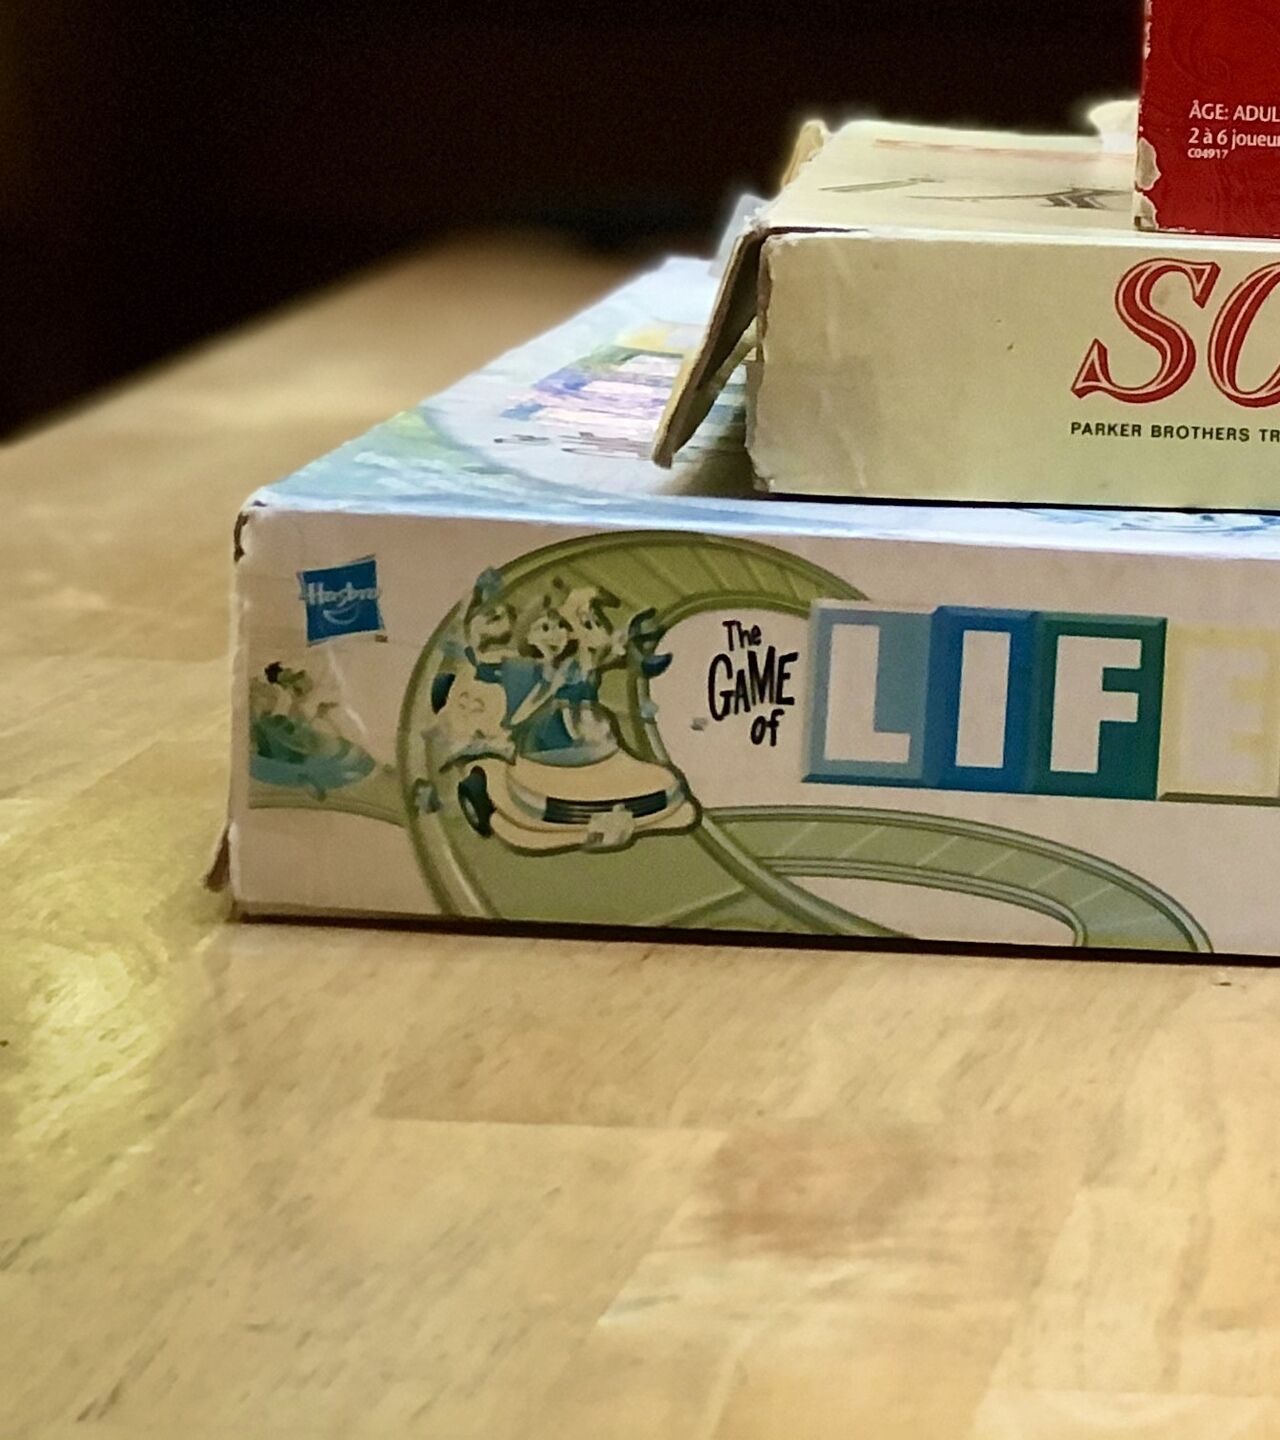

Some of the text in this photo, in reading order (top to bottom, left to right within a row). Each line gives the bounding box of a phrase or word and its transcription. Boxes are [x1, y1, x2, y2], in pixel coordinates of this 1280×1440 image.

[1188, 127, 1199, 144] 2
[1203, 127, 1213, 144] à
[1217, 129, 1228, 145] 6
[1070, 422, 1142, 437] PARKER
[1151, 425, 1250, 442] BROTHERS
[722, 620, 762, 649] The
[708, 646, 798, 722] GAME
[823, 623, 1268, 788] LIFE
[749, 708, 784, 747] of
